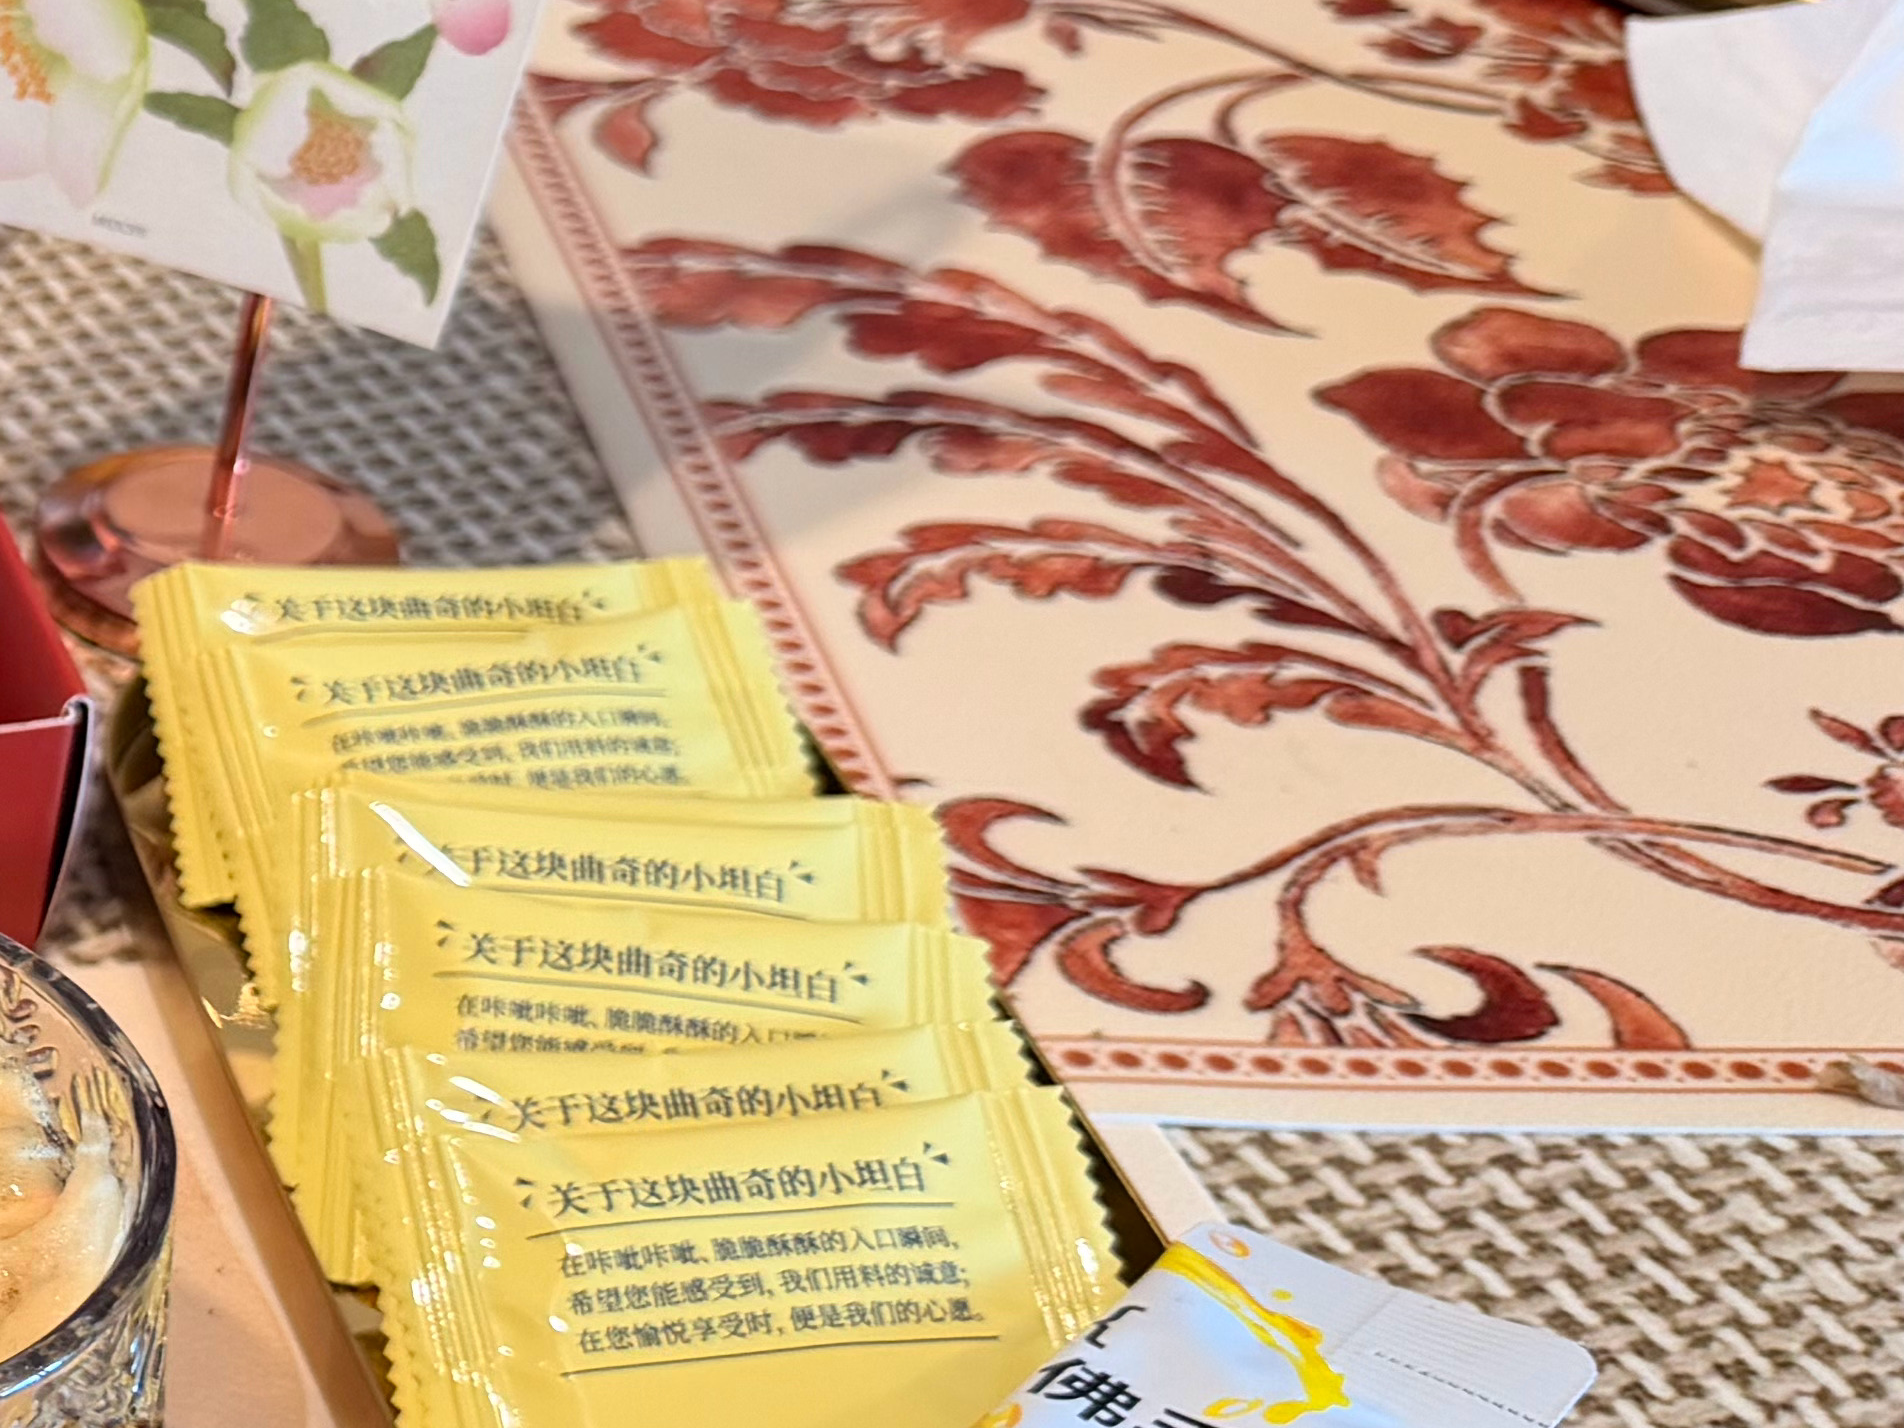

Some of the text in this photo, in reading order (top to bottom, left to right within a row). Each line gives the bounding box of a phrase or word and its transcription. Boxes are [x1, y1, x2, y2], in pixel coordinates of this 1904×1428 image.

[276, 593, 585, 625] 关于这块曲奇的小坦白
[321, 653, 644, 706] 关于这块曲奇的小坦白
[467, 931, 839, 1004] 关于这块曲奇的小坦白
[511, 1080, 882, 1131] 关于这块曲奇的小坦白
[553, 1157, 929, 1217] 关于这块曲奇的小坦白
